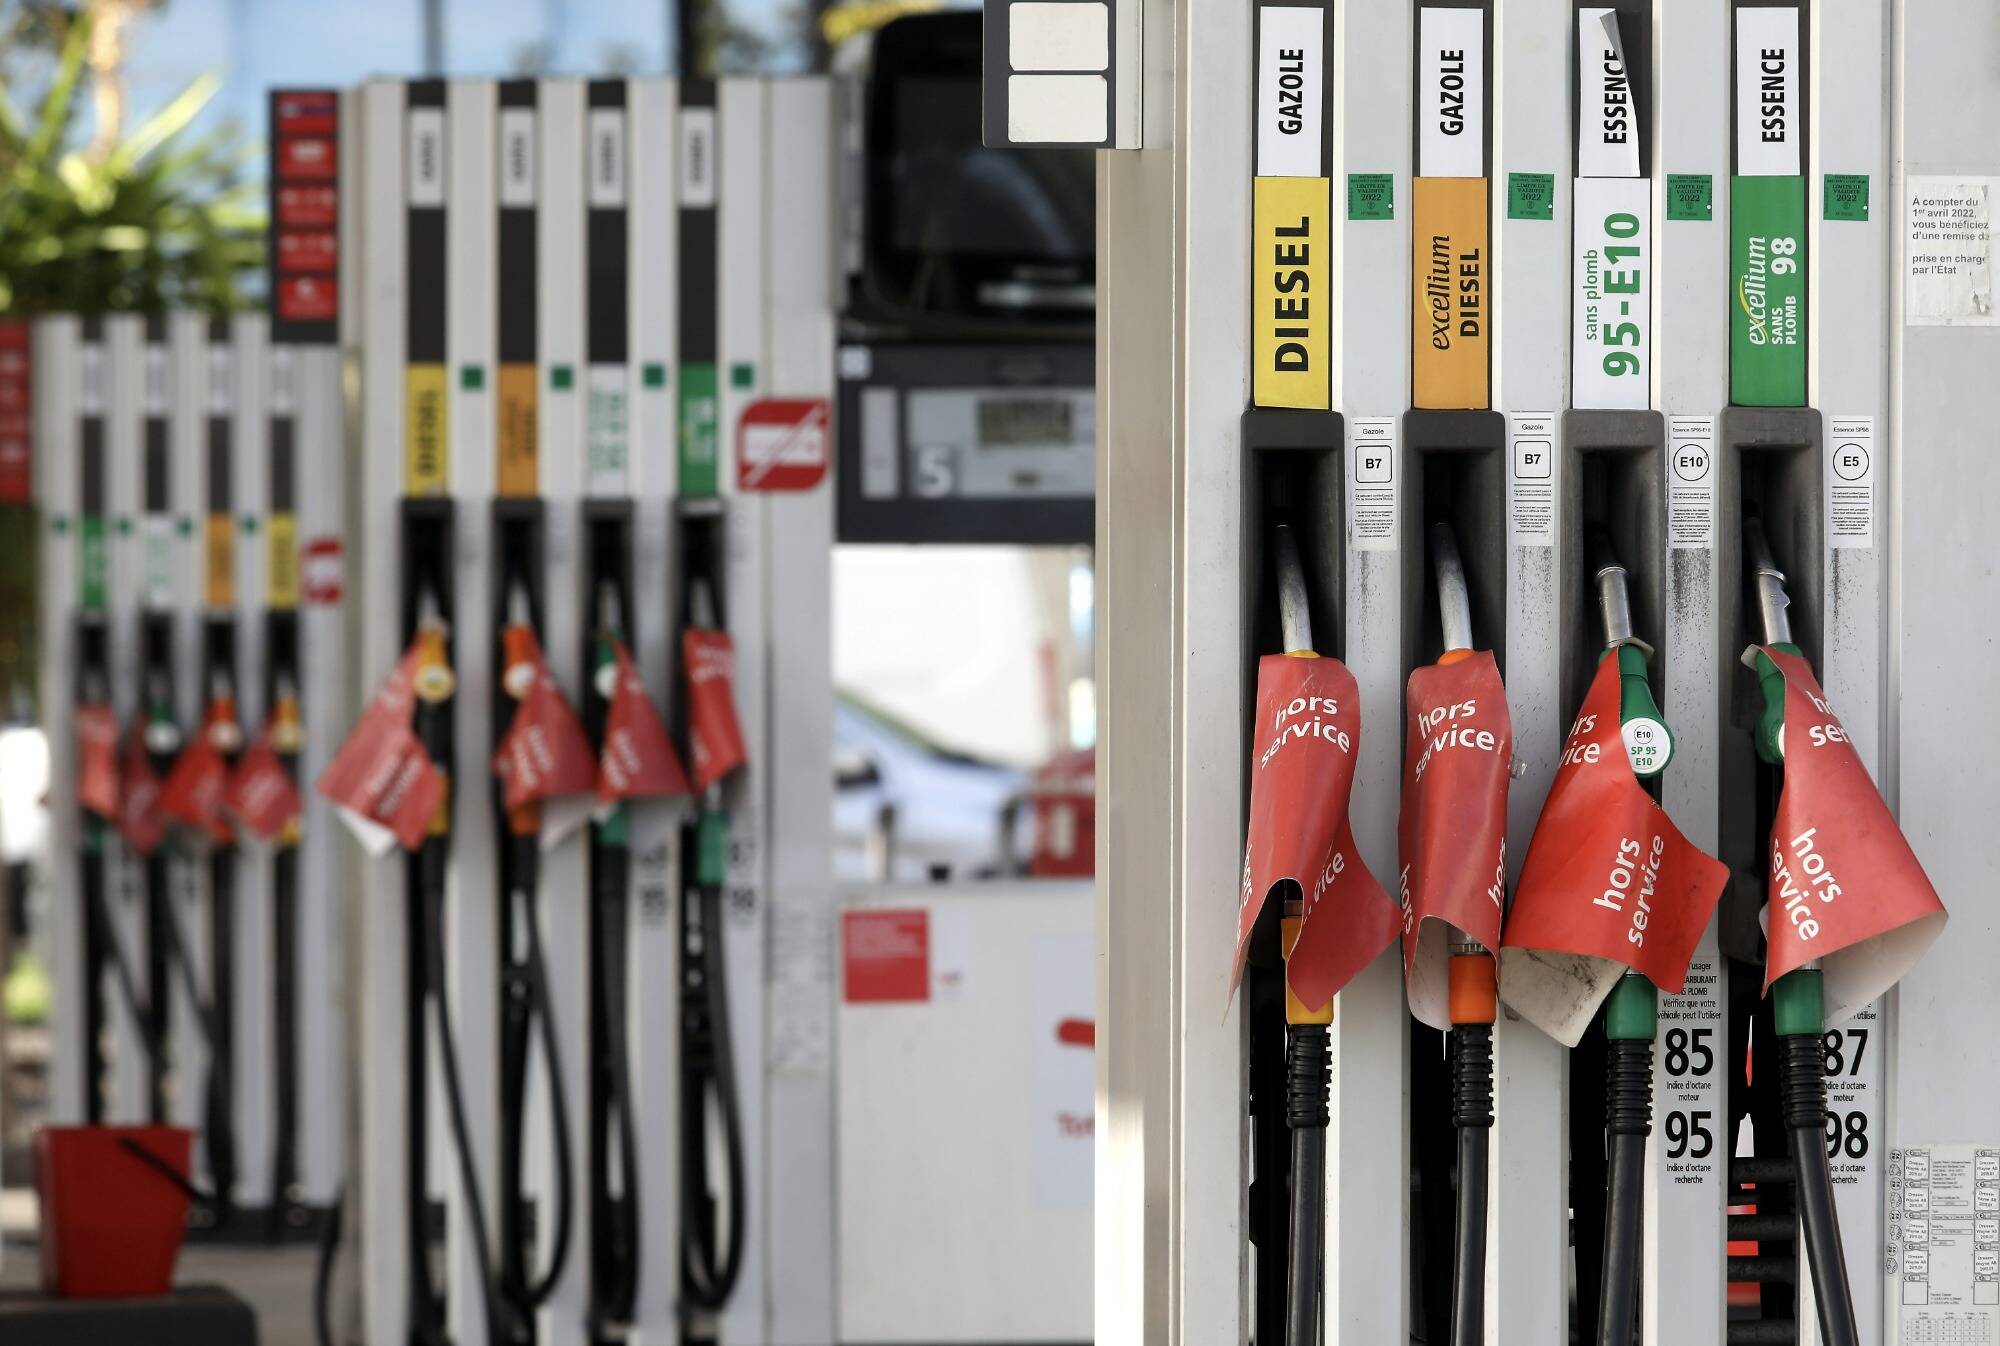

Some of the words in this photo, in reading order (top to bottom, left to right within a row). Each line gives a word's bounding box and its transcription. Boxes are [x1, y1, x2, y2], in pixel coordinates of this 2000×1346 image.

[1279, 48, 1304, 135] GAZOLE
[1440, 49, 1464, 136] GAZOLE
[1761, 48, 1785, 143] ESSENCE
[1520, 193, 1542, 201] 2022
[1679, 194, 1701, 202] 2022
[1836, 194, 1857, 202] 2022
[1922, 198, 1964, 208] compter
[1966, 197, 1979, 206] du
[1927, 209, 1949, 217] avril
[1951, 209, 1977, 219] 2022,
[1912, 221, 1937, 229] vous
[1939, 220, 1989, 229] bénéficiez
[1912, 231, 1940, 240] d'une
[1943, 232, 1976, 240] remise
[1770, 236, 1797, 275] 98
[1912, 254, 1937, 264] prise
[1582, 249, 1602, 300] plomb
[1912, 267, 1929, 275] par
[1931, 263, 1957, 274] l'État
[1274, 216, 1310, 372] DIESEL
[1427, 235, 1450, 351] excellium
[1459, 248, 1479, 337] DIESEL
[1602, 212, 1641, 377] 95-E10
[1747, 236, 1768, 346] excellium
[1586, 305, 1598, 341] sans
[1771, 306, 1783, 345] SANS
[1785, 295, 1797, 345] PLOMB
[1521, 423, 1544, 431] Gazole
[1365, 458, 1382, 469] B7
[1524, 453, 1541, 465] B7
[1680, 456, 1703, 468] E10
[1843, 456, 1859, 467] E5
[1275, 695, 1338, 731] hors
[1416, 699, 1477, 740] hors
[1636, 731, 1651, 739] E10
[1261, 716, 1350, 769] service
[1414, 723, 1495, 783] service
[1631, 746, 1643, 755] SP
[1645, 746, 1657, 755] 95
[1635, 757, 1653, 766] E10
[1791, 827, 1842, 903] hors
[1592, 836, 1641, 912] hors
[1628, 835, 1664, 948] service
[1772, 837, 1820, 941] service
[1684, 975, 1717, 984] ARBURANT
[1688, 987, 1708, 996] PLOMB
[1663, 999, 1686, 1008] Vérifiez
[1686, 1000, 1698, 1009] que
[1699, 999, 1716, 1008] votre
[1656, 1010, 1681, 1019] véhicule
[1682, 1011, 1696, 1021] peut
[1698, 1010, 1721, 1019] l'utiliser
[1664, 1027, 1714, 1077] 85
[1823, 1028, 1869, 1077] 87
[1666, 1081, 1684, 1089] Indice
[1685, 1081, 1712, 1089] d'octane
[1824, 1081, 1840, 1090] ndice
[1840, 1081, 1867, 1090] d'octane
[1678, 1093, 1700, 1101] moteur
[1833, 1094, 1855, 1102] moteur
[1665, 1110, 1713, 1159] 95
[1826, 1111, 1869, 1159] 98
[1666, 1163, 1684, 1172] Indice
[1685, 1163, 1712, 1172] d'octane
[1840, 1163, 1866, 1172] d'octane
[1674, 1175, 1703, 1184] recherche
[1832, 1175, 1859, 1184] echerche
